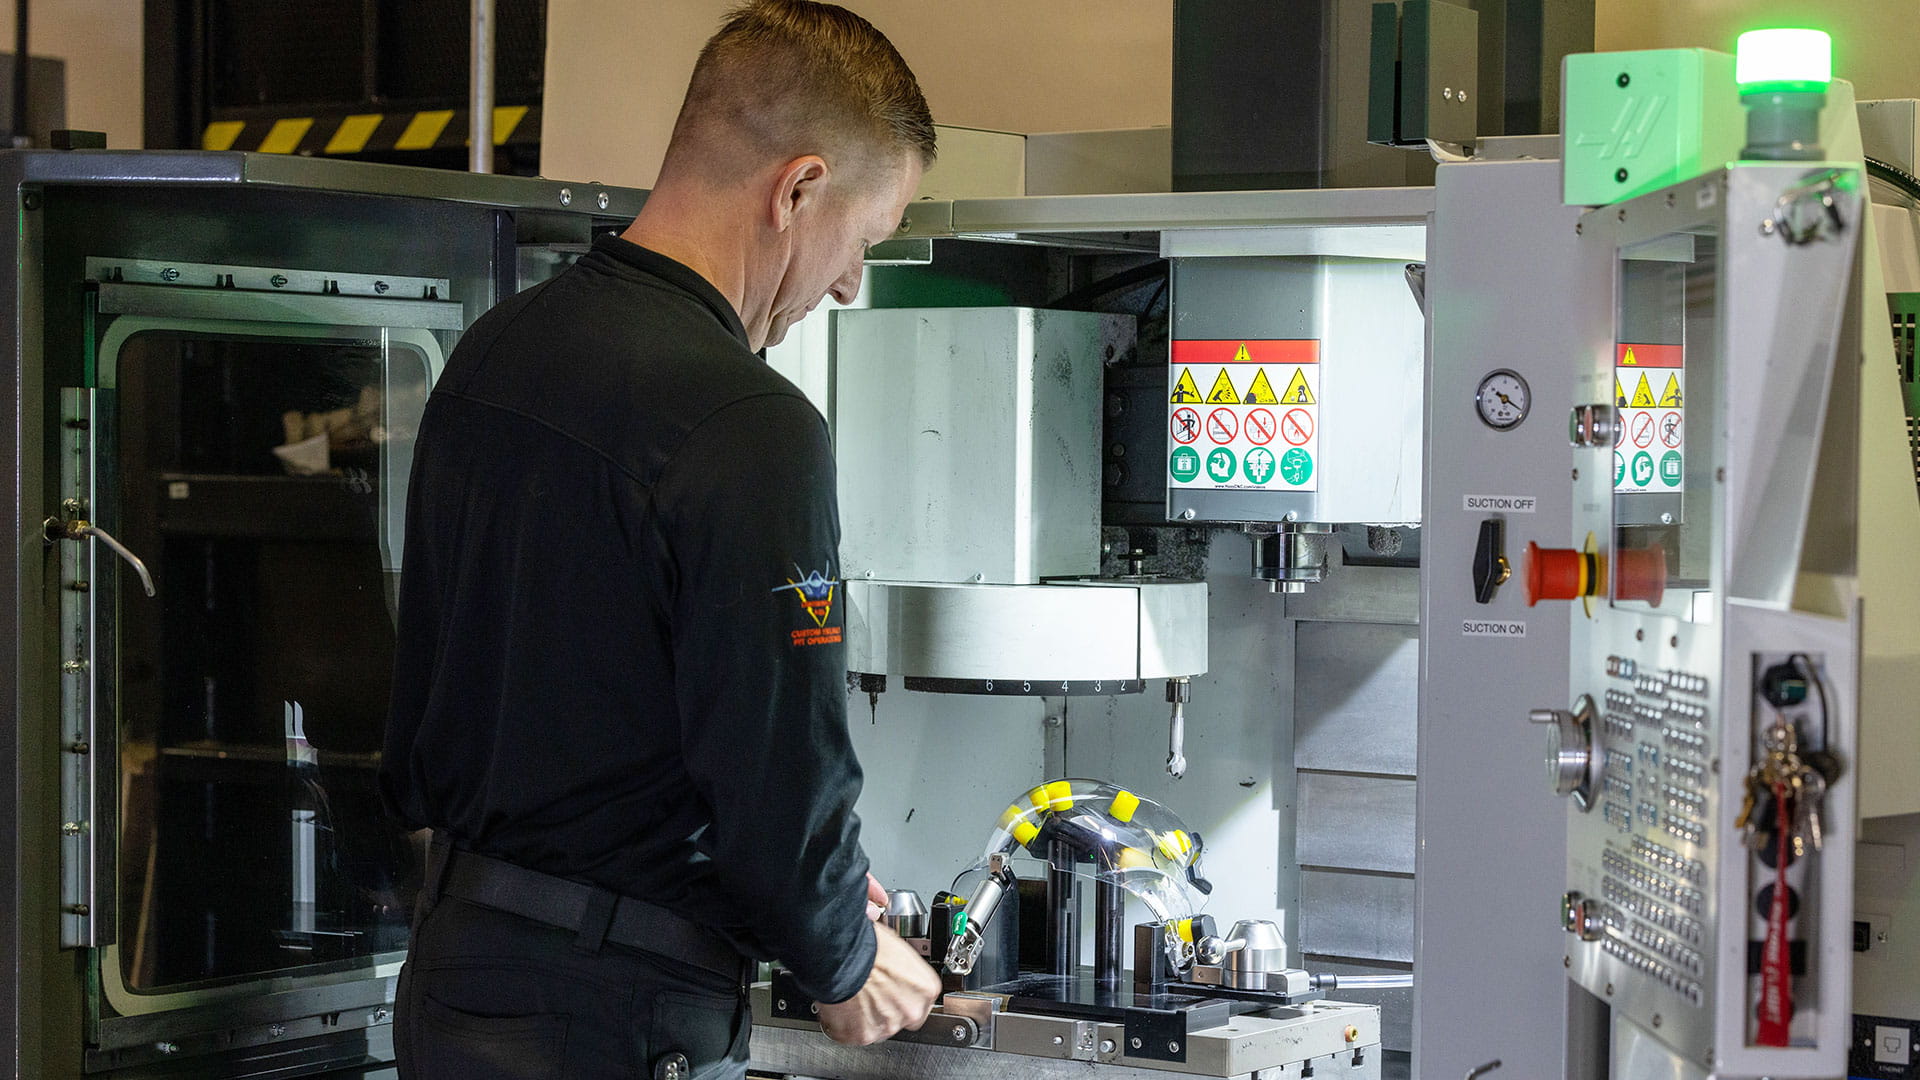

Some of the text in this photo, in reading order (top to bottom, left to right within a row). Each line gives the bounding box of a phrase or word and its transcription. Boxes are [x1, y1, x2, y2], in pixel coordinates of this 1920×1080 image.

[1467, 497, 1534, 509] SUCTION OFF
[1463, 622, 1524, 634] SUCTION ON
[986, 680, 1126, 692] 6 5 4 3 2
